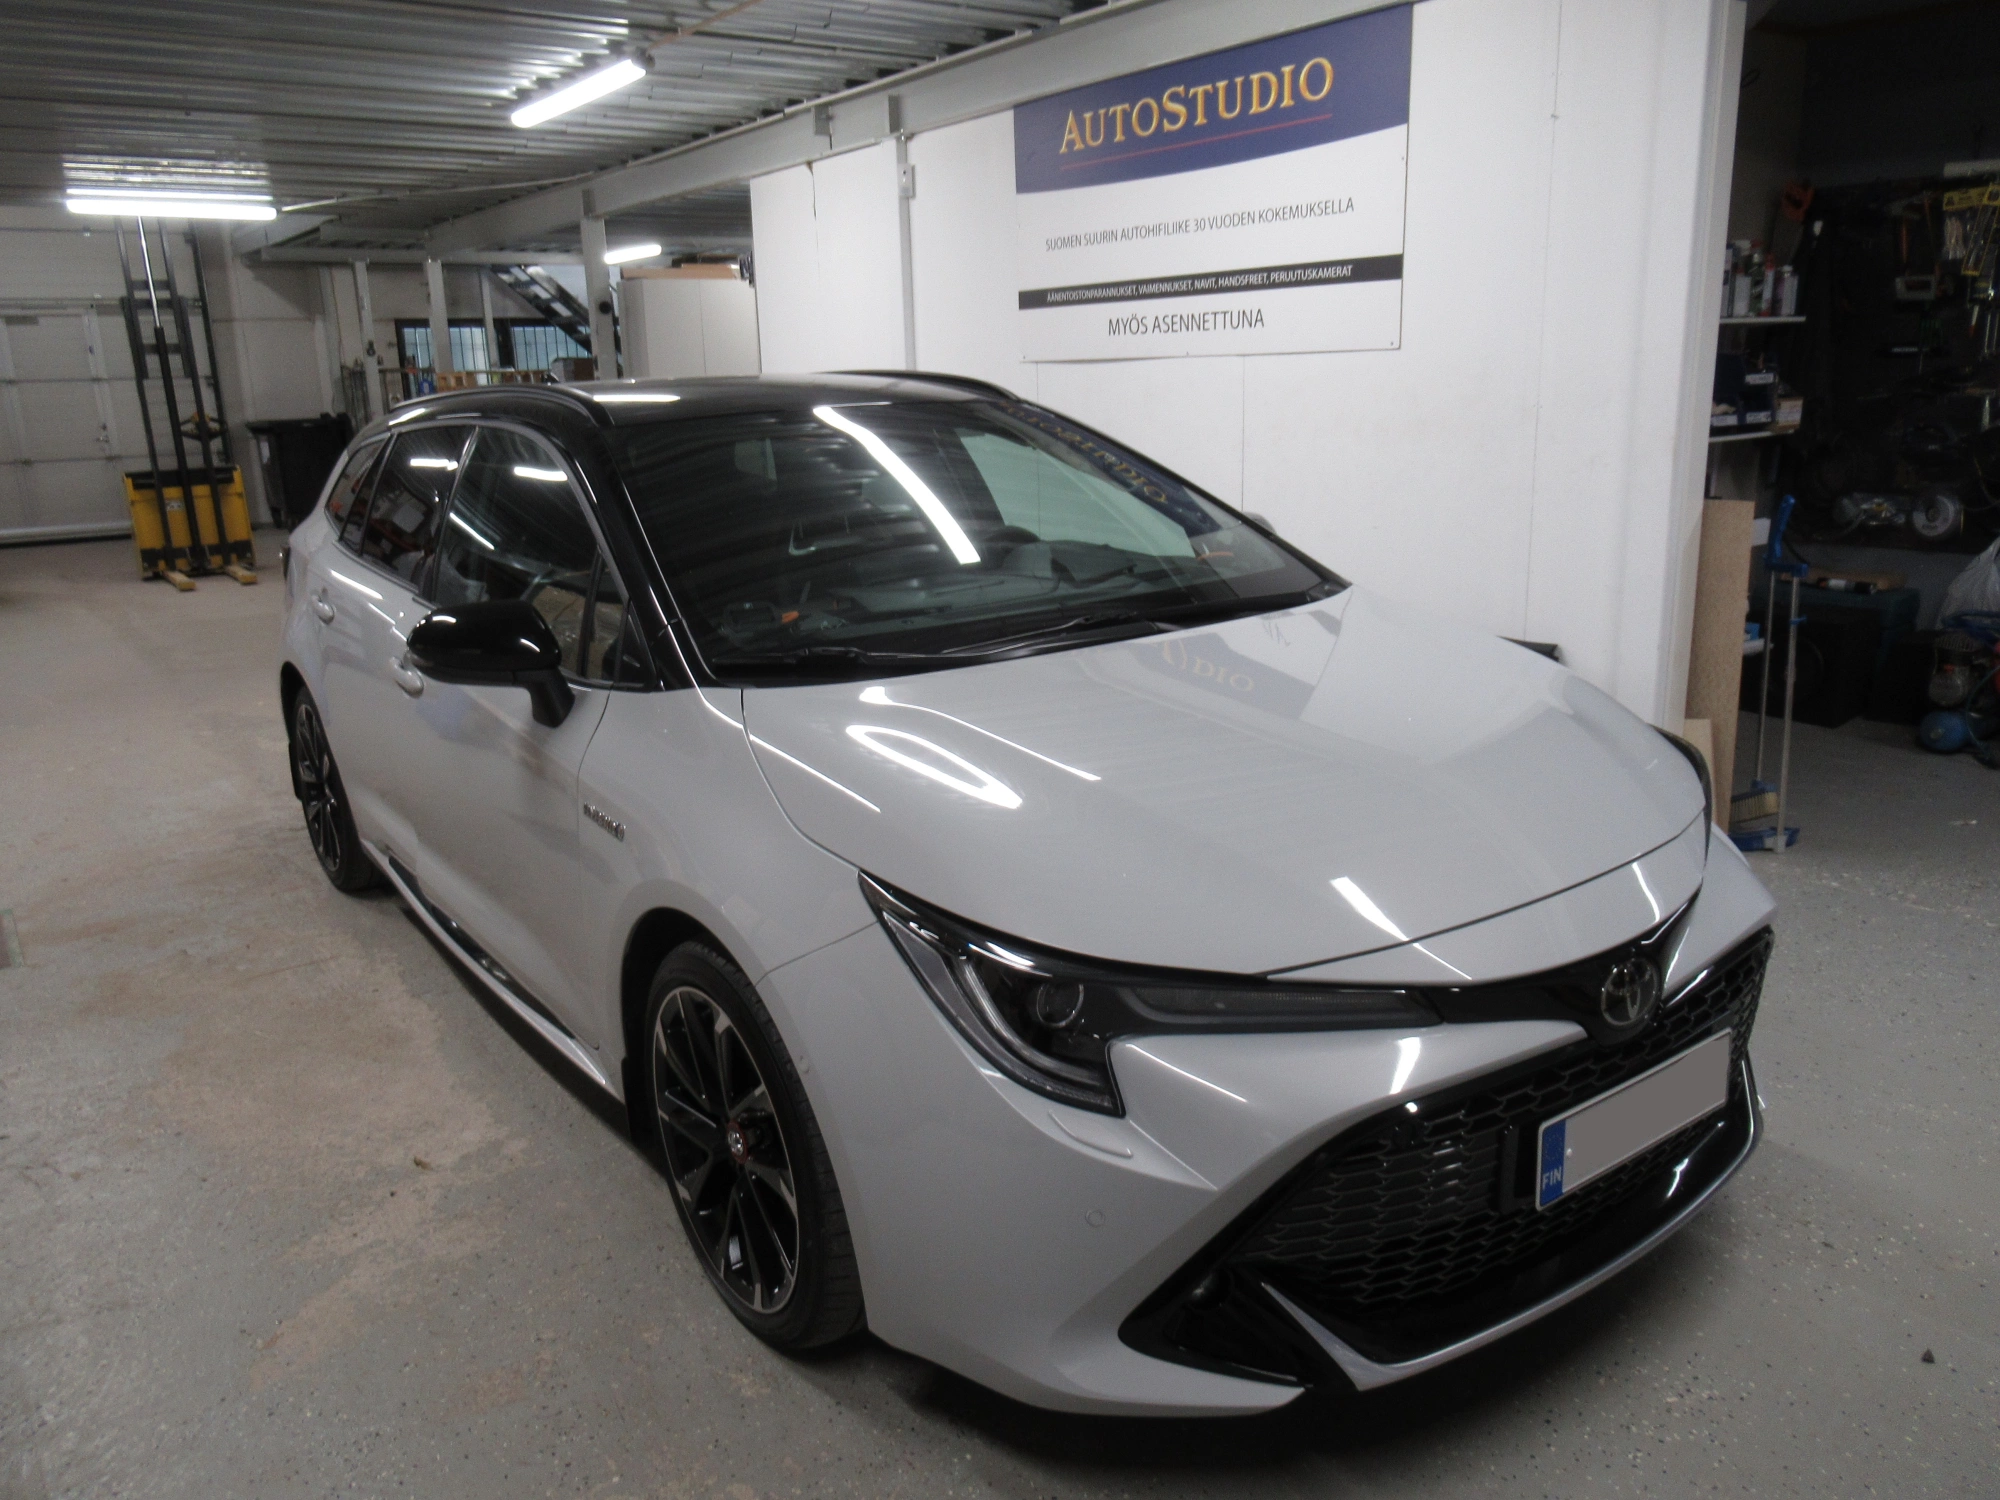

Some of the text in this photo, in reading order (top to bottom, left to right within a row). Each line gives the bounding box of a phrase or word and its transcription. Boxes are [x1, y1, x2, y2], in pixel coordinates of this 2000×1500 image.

[1059, 57, 1334, 154] AUTOSTUDIO
[1045, 197, 1354, 252] SUOMEN SUURIN AUTOHIFILIIKE 30 VUODEN KOKEMUKSELLA
[1138, 279, 1194, 296] VAIMENNUKSET,
[1194, 277, 1218, 290] NAVIT,
[1218, 272, 1268, 288] HANDSFREET,
[1270, 265, 1353, 283] PERUUTUSKAMERAT
[1108, 309, 1264, 336] MYÖS ASENNETTUNA
[1542, 1165, 1562, 1191] FIN
